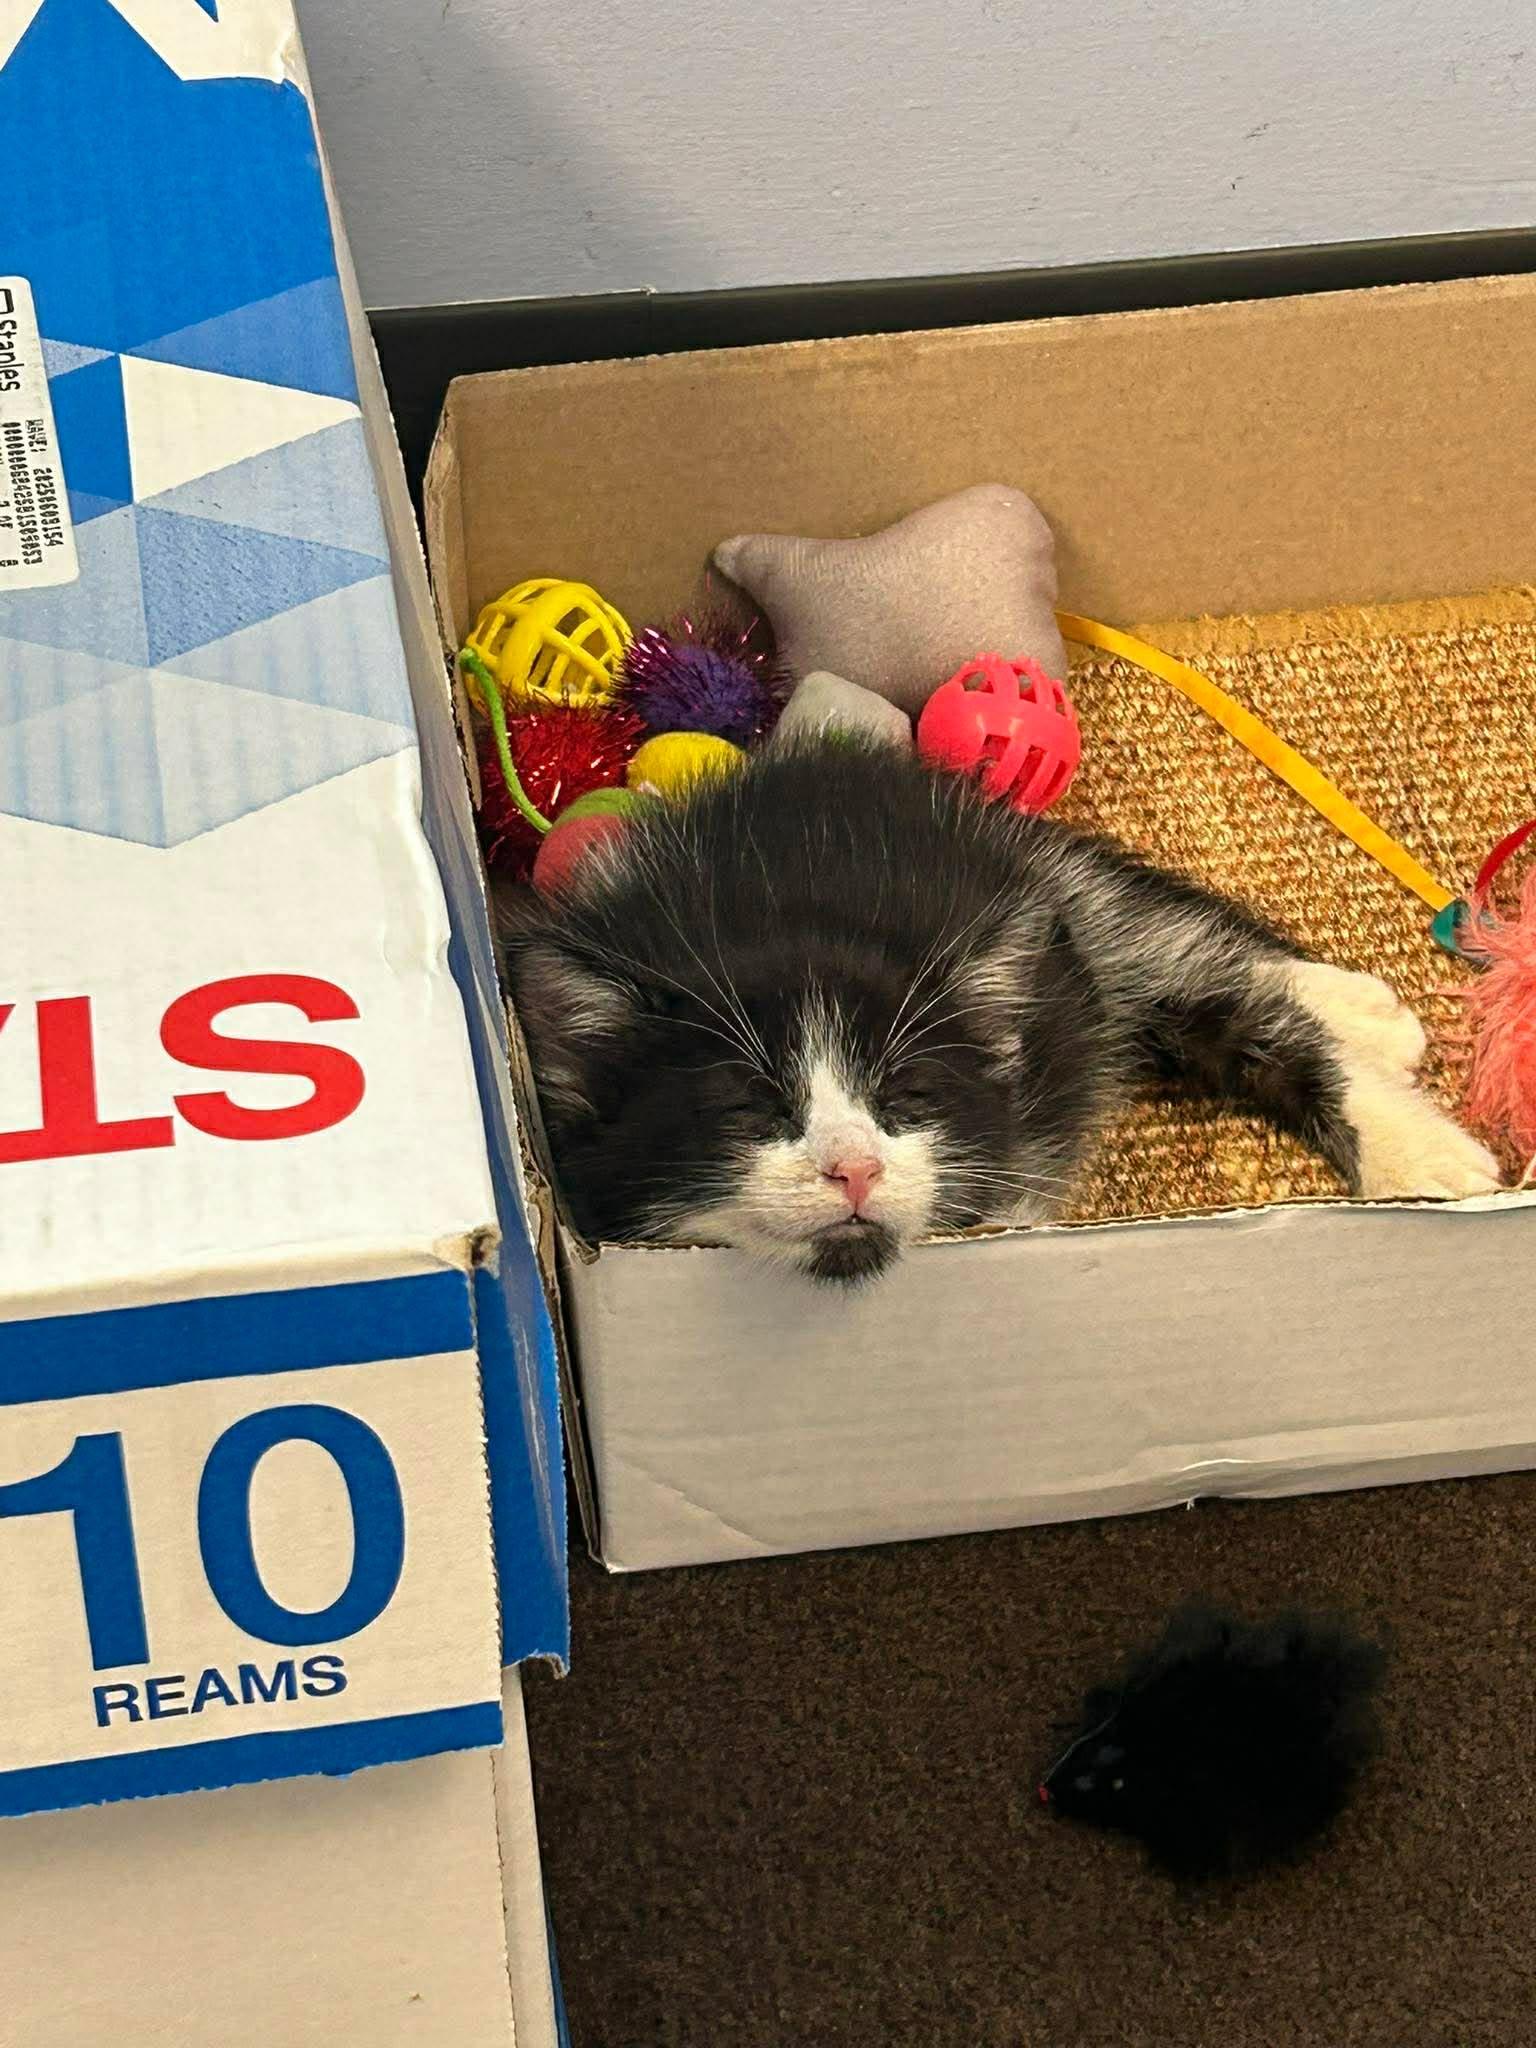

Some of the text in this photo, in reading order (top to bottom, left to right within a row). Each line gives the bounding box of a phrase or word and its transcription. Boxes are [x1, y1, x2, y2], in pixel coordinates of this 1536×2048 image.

[0, 973, 366, 1164] ST
[0, 1403, 405, 1671] 10
[93, 1655, 348, 1727] REAMS
